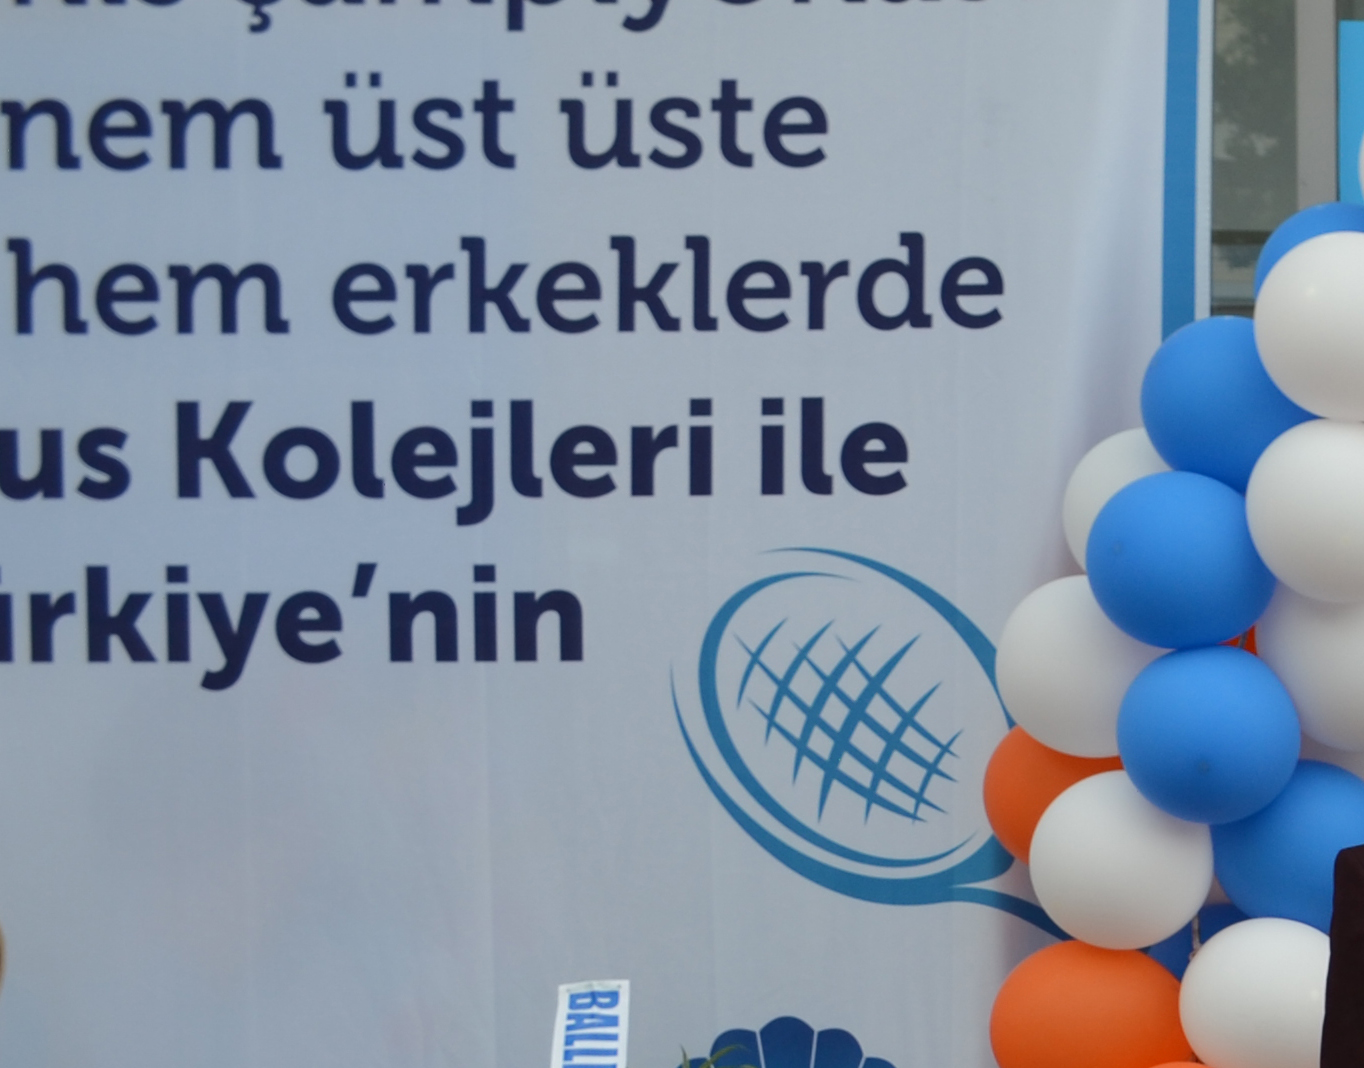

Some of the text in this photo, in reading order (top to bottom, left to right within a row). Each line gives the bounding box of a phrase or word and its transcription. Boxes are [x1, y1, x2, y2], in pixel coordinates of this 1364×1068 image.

[323, 72, 516, 172] üst
[559, 72, 828, 171] üste
[5, 231, 1004, 337] hem erkeklerde
[176, 397, 713, 527] Kolejleri
[760, 396, 909, 496] ile
